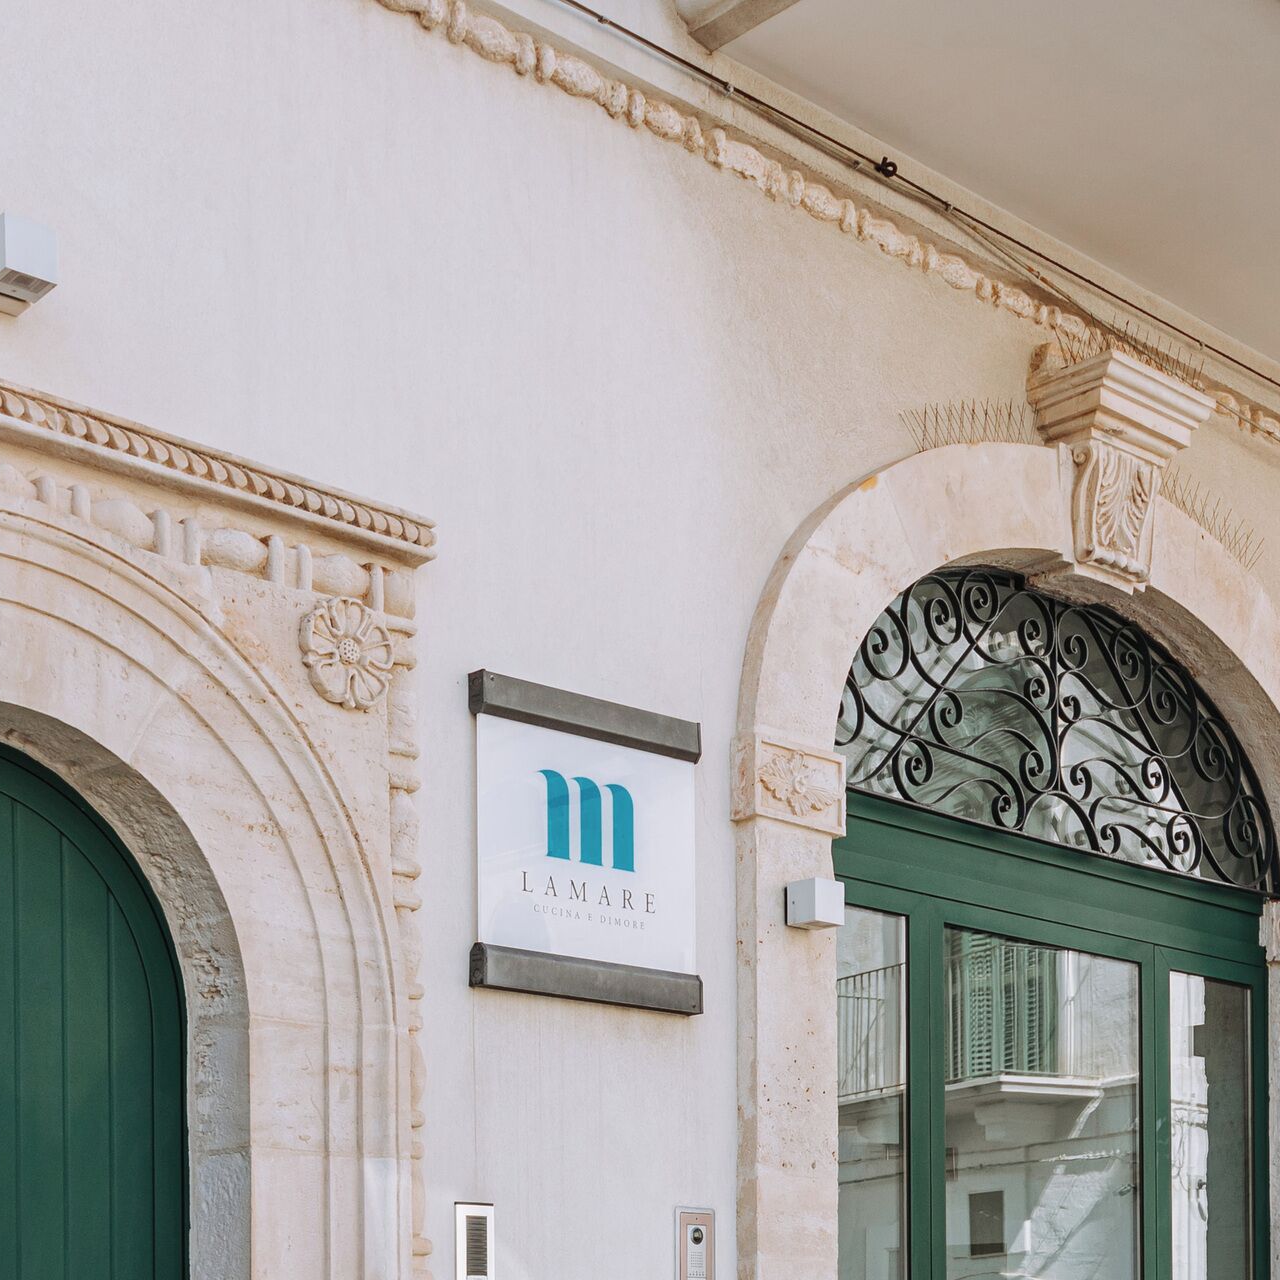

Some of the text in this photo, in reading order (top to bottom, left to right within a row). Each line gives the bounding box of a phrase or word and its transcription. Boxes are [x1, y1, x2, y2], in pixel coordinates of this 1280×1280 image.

[522, 871, 656, 914] LAMARE
[533, 904, 646, 930] CUCINA E DIMORE
